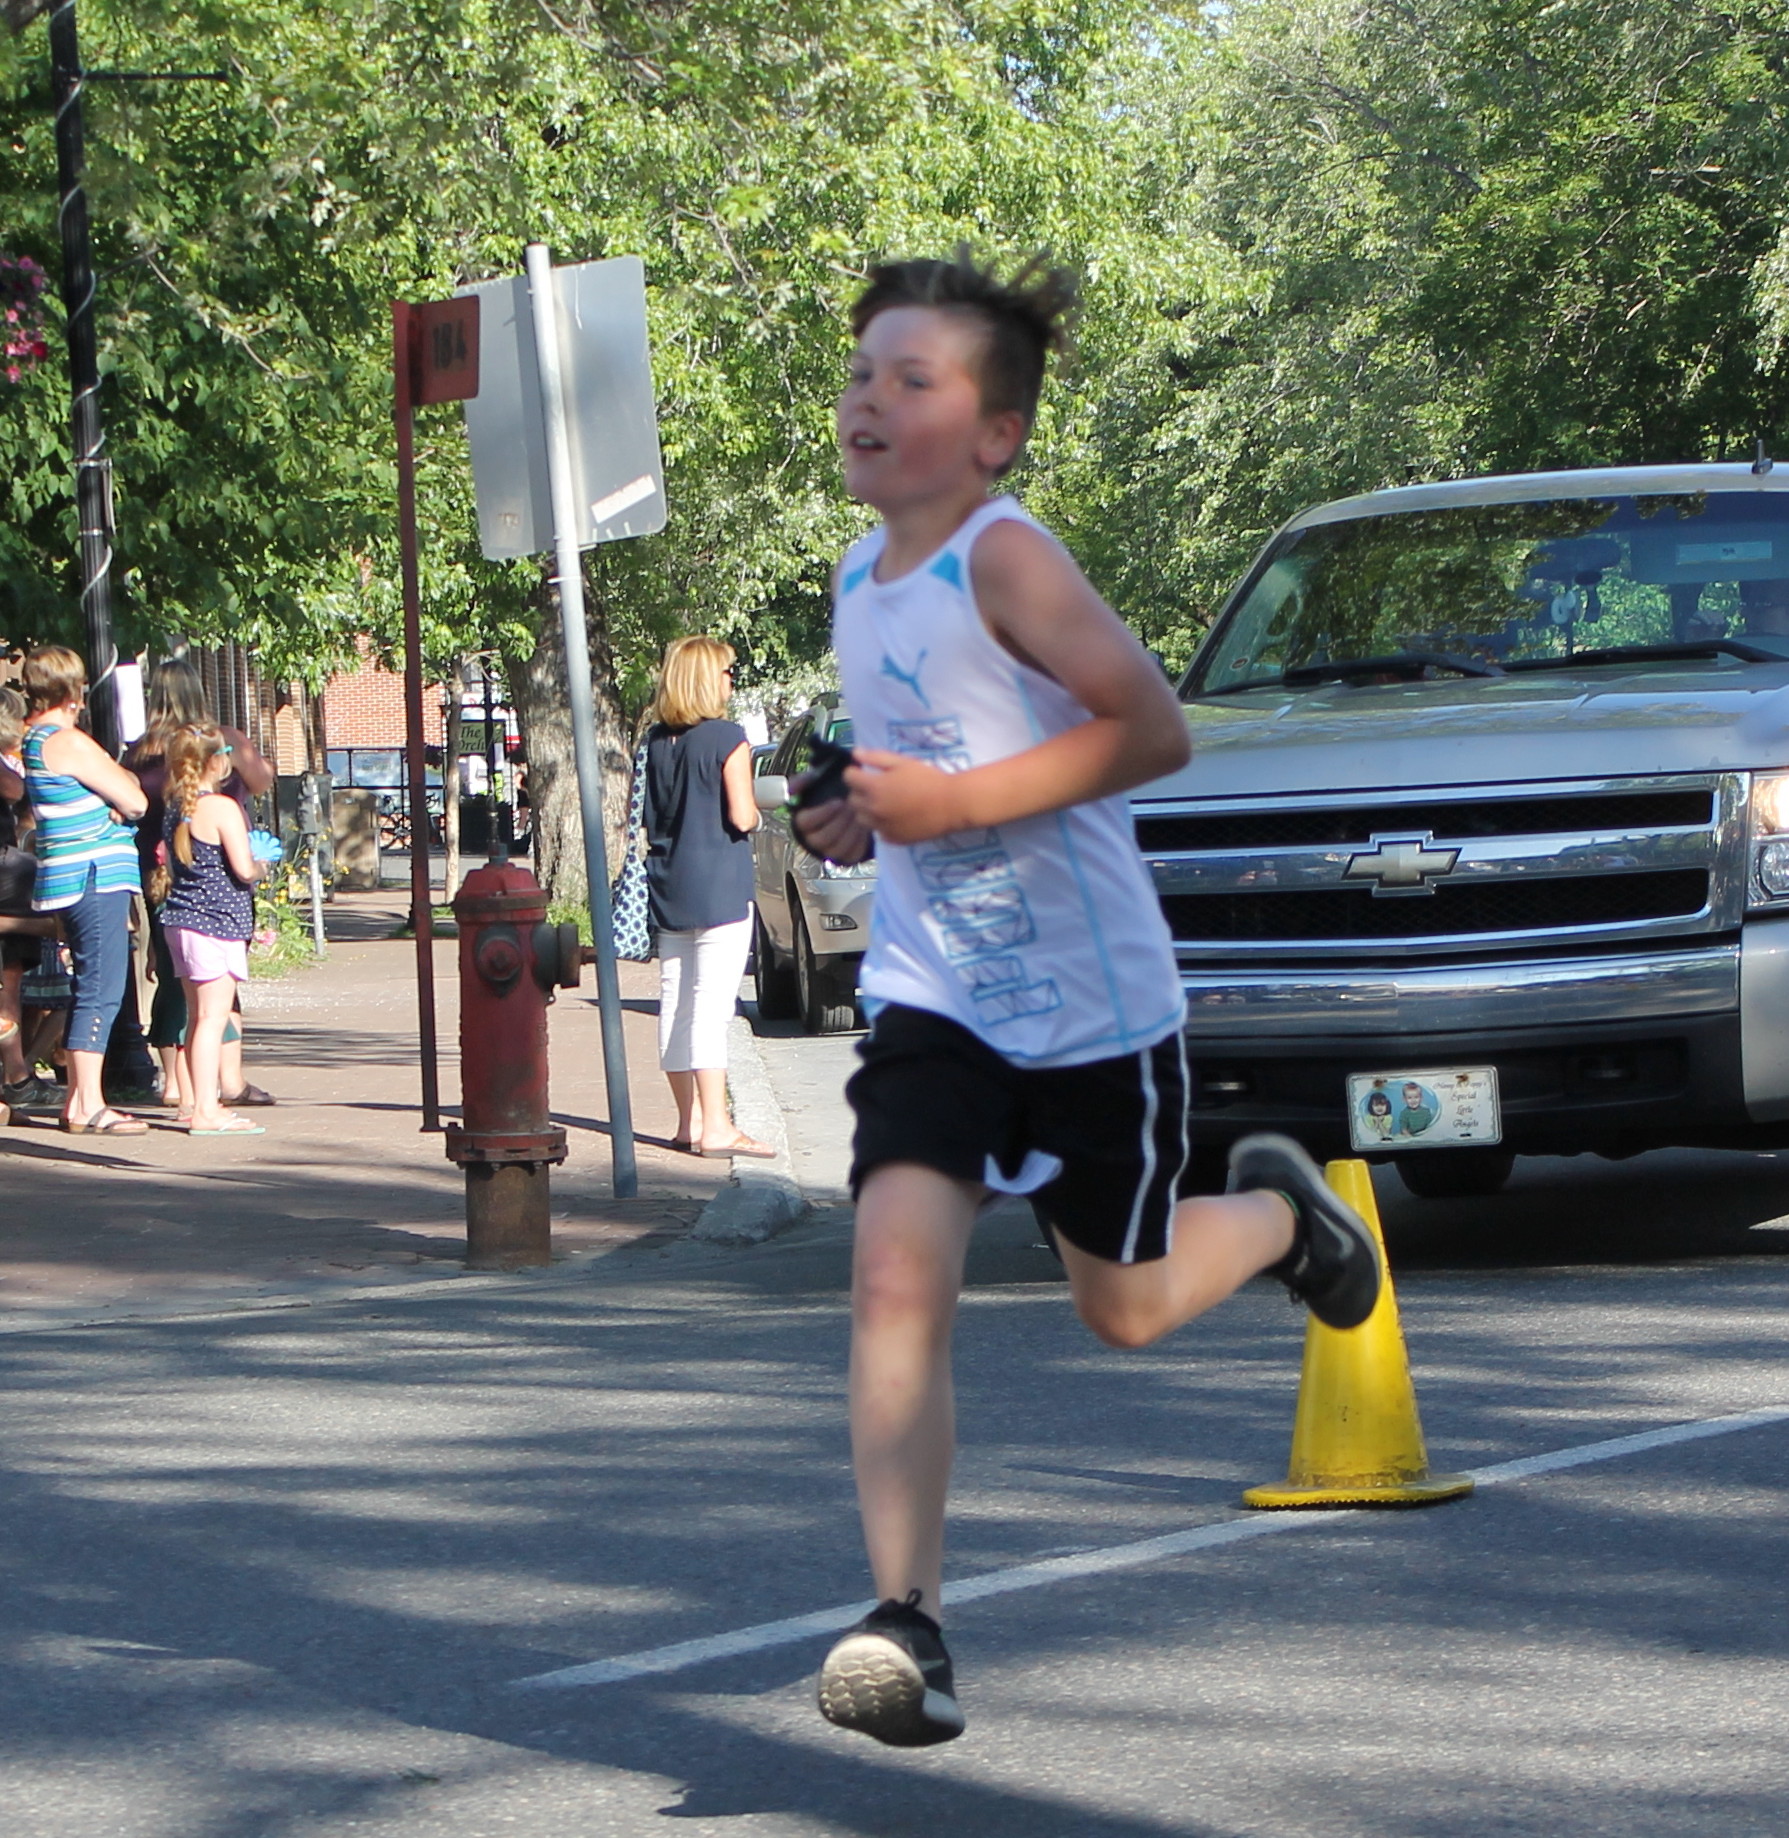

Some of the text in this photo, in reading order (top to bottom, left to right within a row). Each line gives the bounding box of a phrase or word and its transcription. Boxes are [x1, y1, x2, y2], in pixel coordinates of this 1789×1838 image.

[461, 726, 481, 738] The
[1451, 1091, 1477, 1102] Special
[1452, 1119, 1479, 1131] Angels
